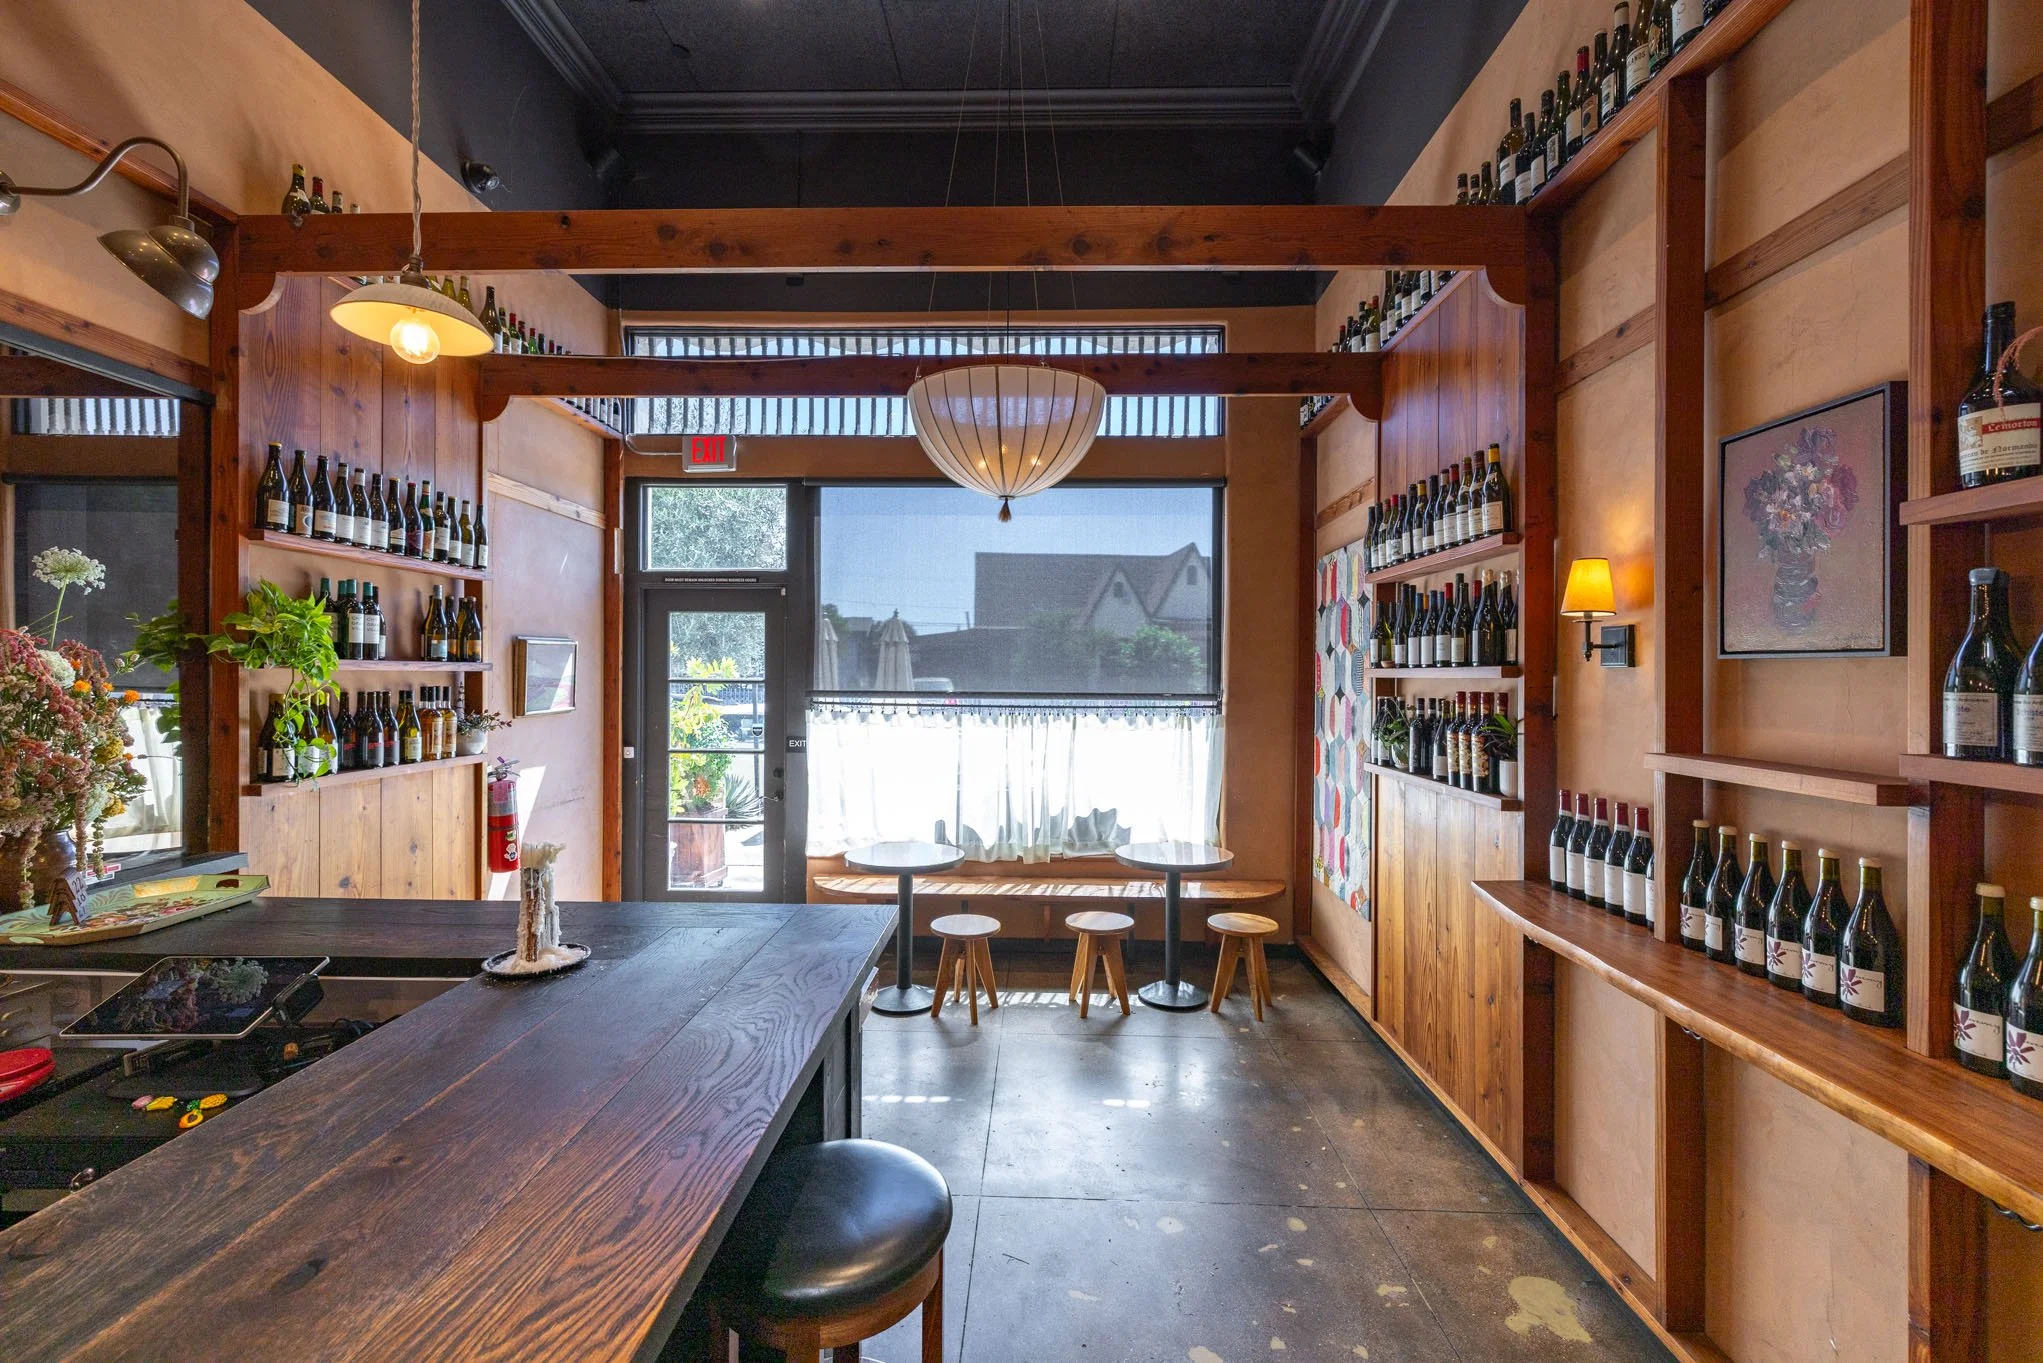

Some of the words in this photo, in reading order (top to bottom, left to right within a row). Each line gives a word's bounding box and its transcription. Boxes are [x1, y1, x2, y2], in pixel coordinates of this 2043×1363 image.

[691, 435, 727, 463] EXIT
[788, 739, 807, 748] EXIT
[72, 877, 83, 893] 22
